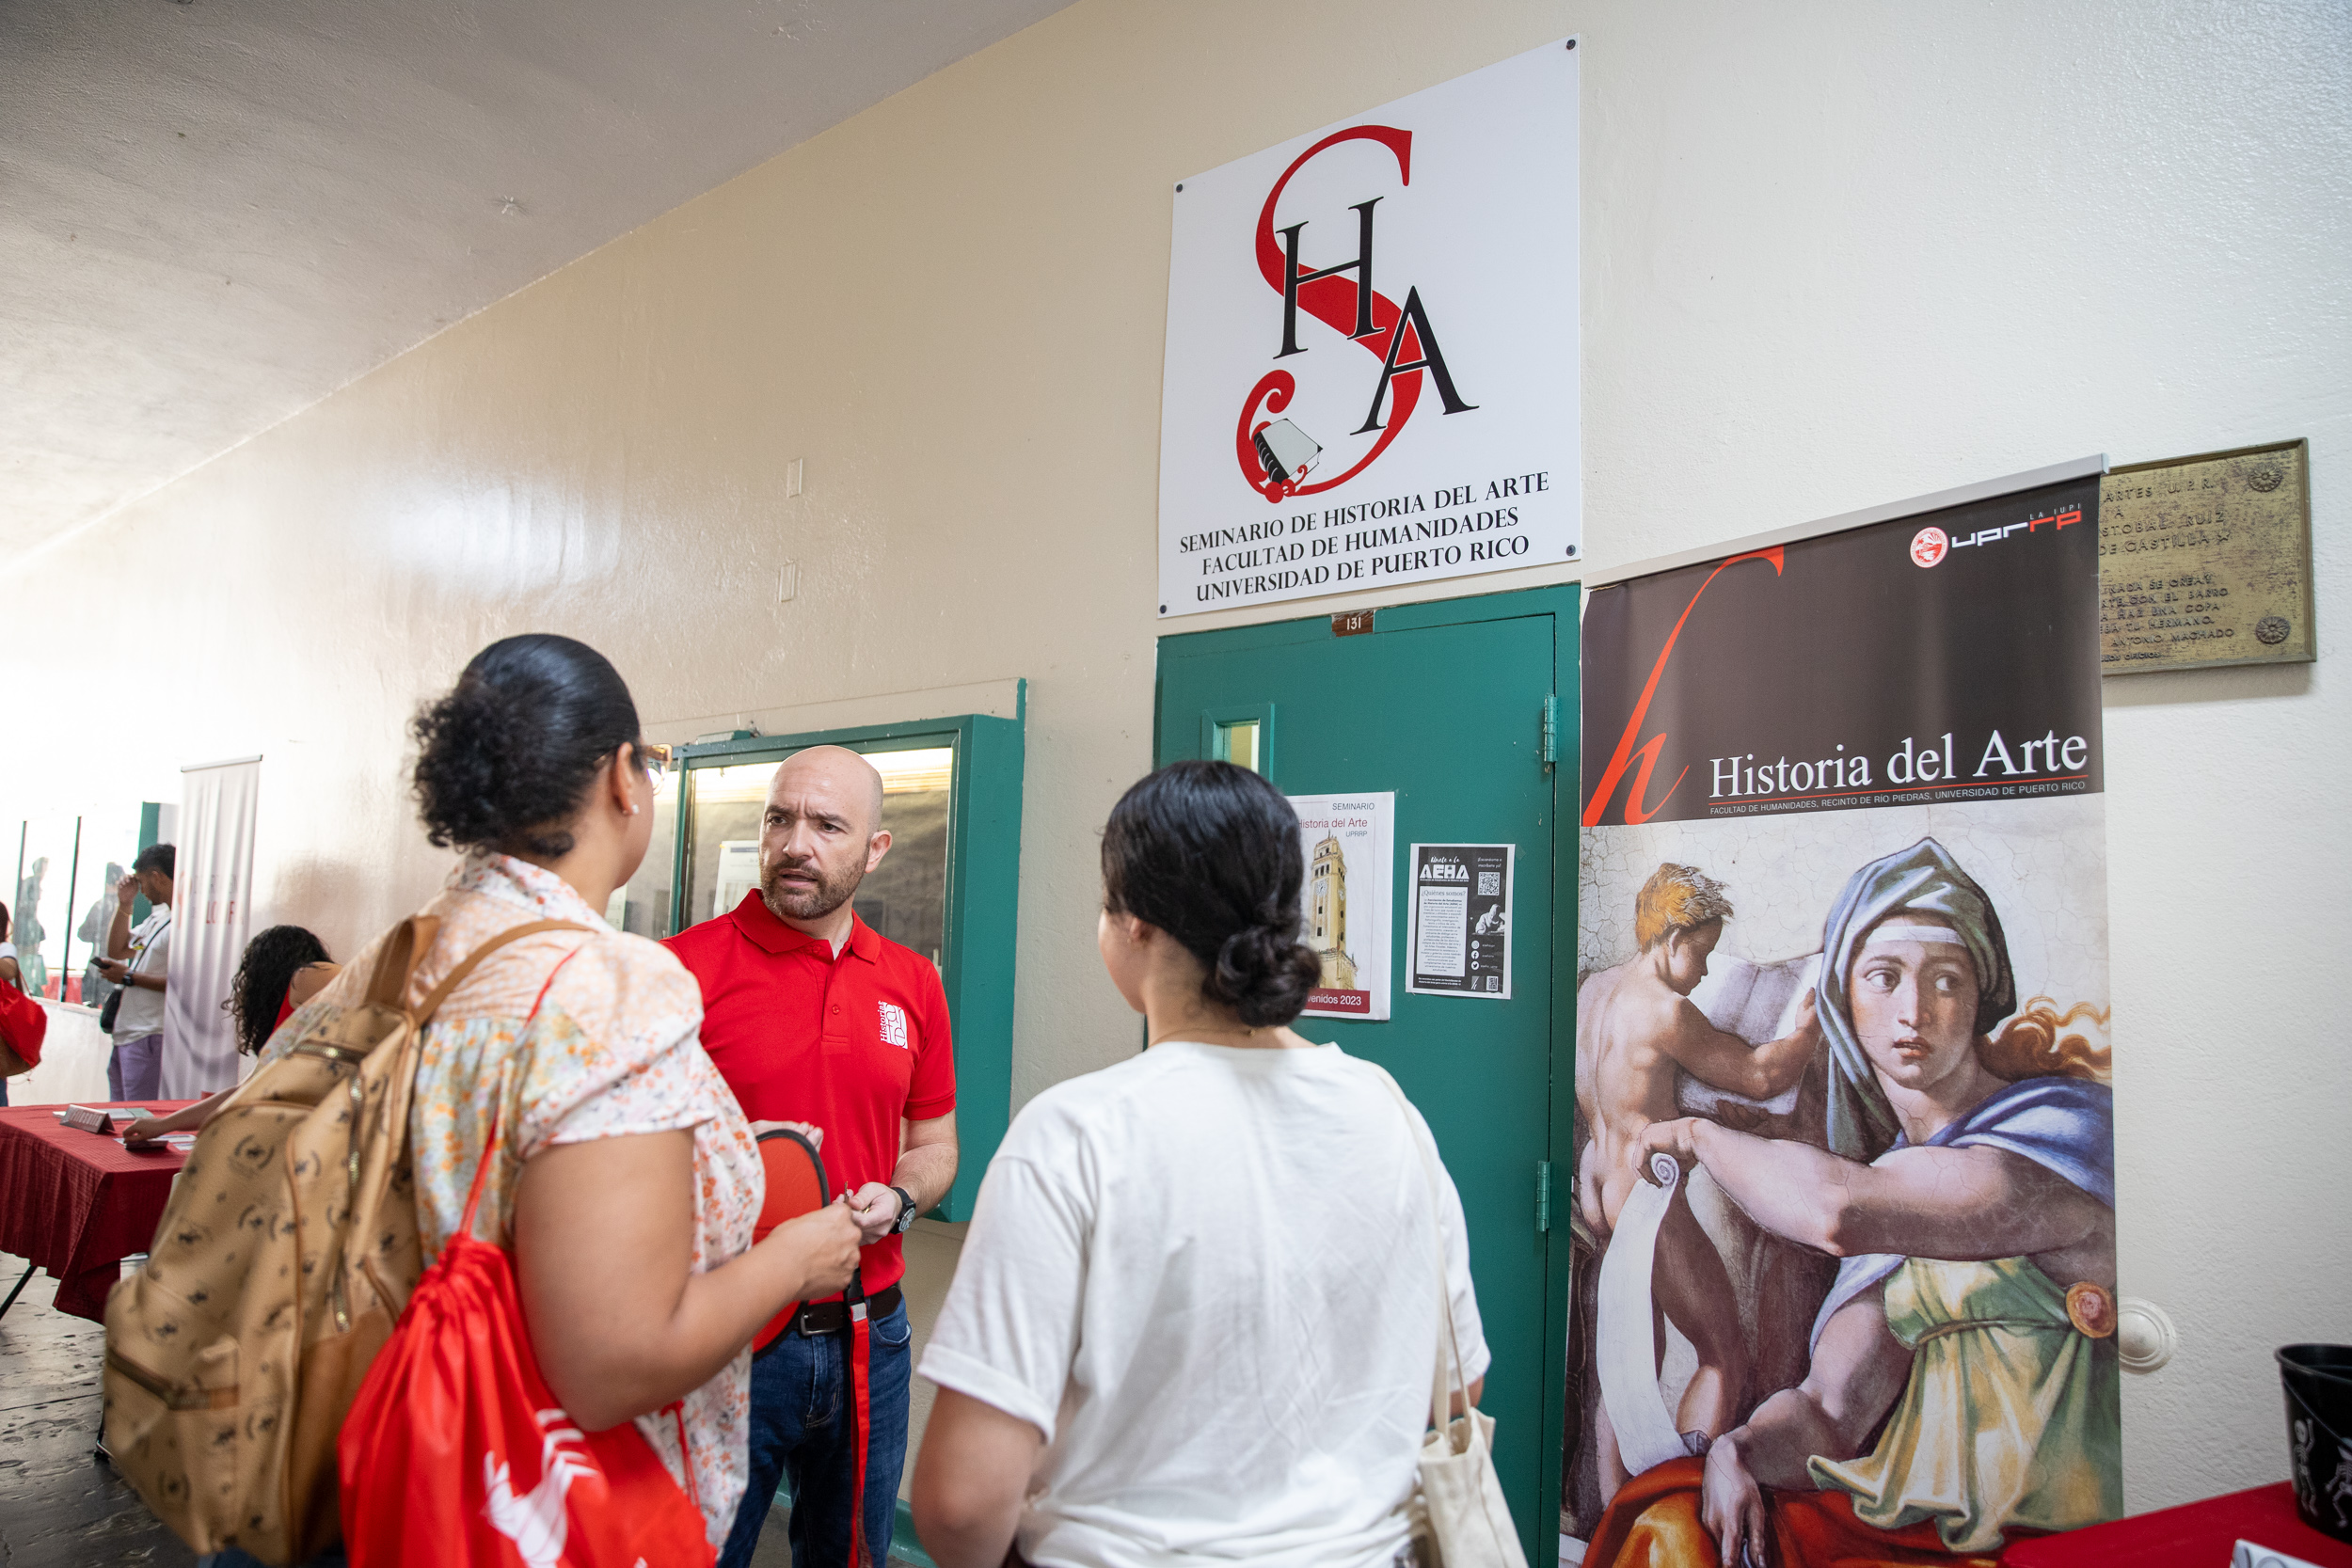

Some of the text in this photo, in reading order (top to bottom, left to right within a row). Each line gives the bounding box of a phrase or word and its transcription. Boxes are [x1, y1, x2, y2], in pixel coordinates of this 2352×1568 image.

[2104, 486, 2153, 503] ARTES
[1180, 471, 1549, 554] SEMINARIO DE HISTORIA DEL ARTE
[2029, 502, 2081, 520] LA IUPI
[1202, 506, 1518, 576] FACULTAD DE HUMANIDADES
[2124, 532, 2210, 552] CASTILLA
[1197, 534, 1530, 601] UNIVERSIDAD DE PUERTO RICO
[1346, 616, 1361, 630] 131
[2111, 628, 2234, 647] ANTONIO MACHADO
[1708, 729, 2089, 799] Historia del Arte
[1332, 802, 1375, 811] SEMINARIO
[1709, 805, 1747, 816] FACULTAD
[1748, 804, 1758, 813] DE
[1821, 797, 1857, 807] RECINTO
[1859, 796, 1871, 804] DE
[1873, 793, 1889, 803] RÍO
[1935, 787, 1999, 800] UNIVERSIDAD
[2002, 785, 2016, 795] DE
[2018, 783, 2058, 794] PUERTO
[2061, 781, 2086, 791] RICO
[1331, 817, 1345, 828] del
[1347, 817, 1368, 828] Arte
[1419, 863, 1470, 879] AEHA
[1307, 993, 1362, 1006] venidos 2023
[877, 1004, 888, 1041] Historia
